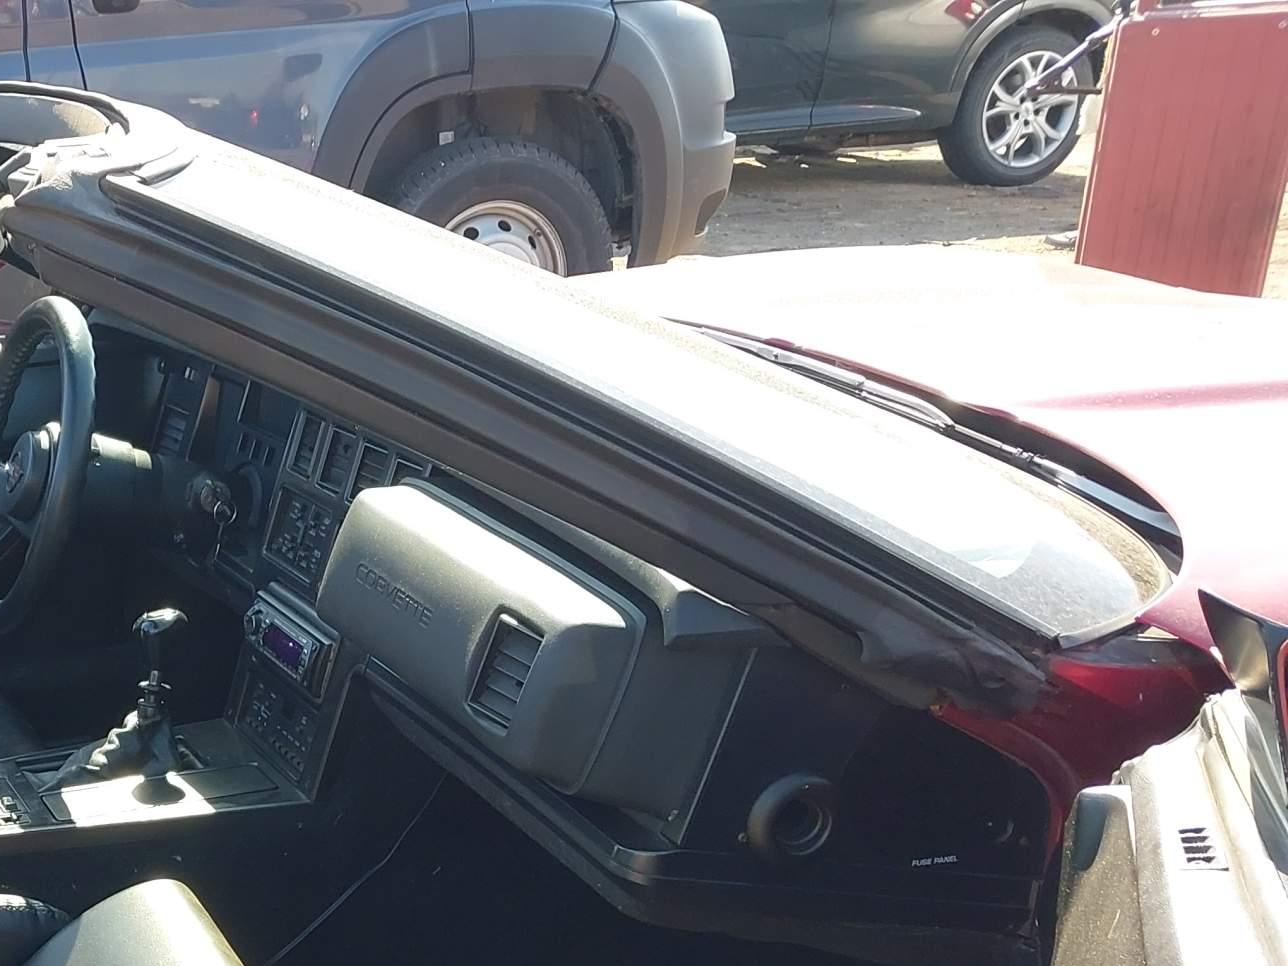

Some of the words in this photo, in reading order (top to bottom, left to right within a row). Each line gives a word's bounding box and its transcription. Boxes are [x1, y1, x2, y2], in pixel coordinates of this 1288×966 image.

[355, 561, 434, 631] CORVETTE
[911, 858, 932, 866] FUSE
[933, 855, 957, 864] PANEL
